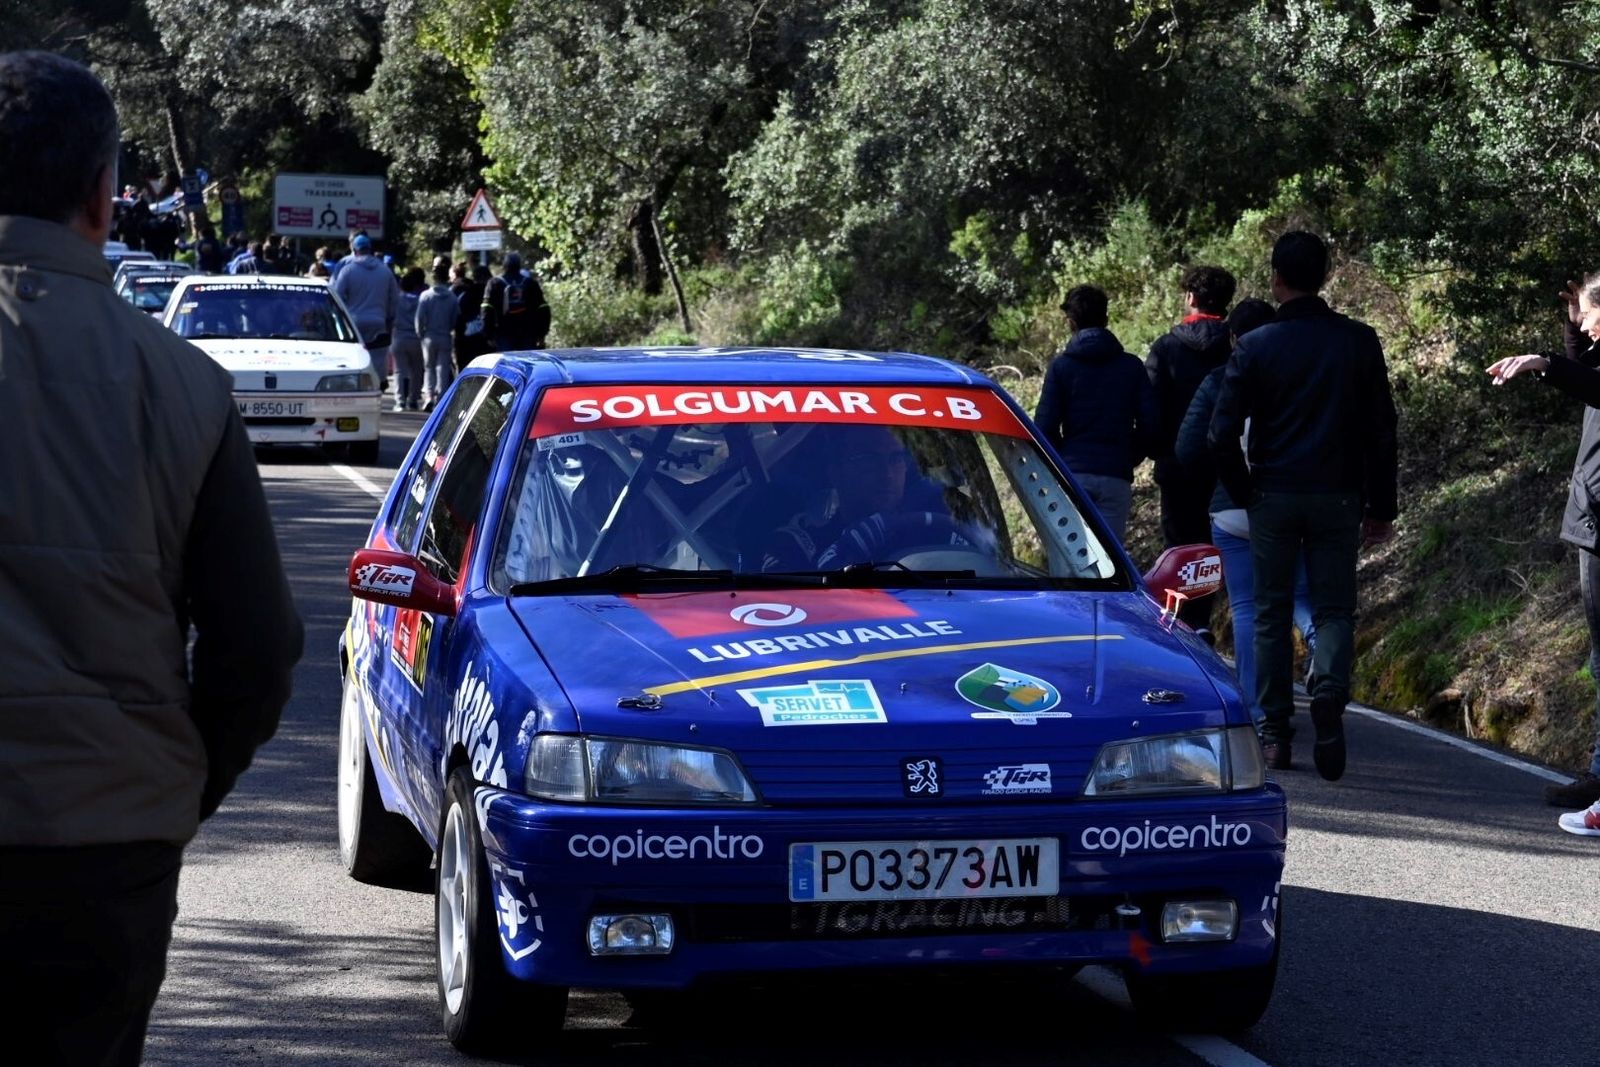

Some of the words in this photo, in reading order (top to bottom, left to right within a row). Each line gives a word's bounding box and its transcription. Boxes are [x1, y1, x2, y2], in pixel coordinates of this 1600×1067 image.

[570, 390, 877, 423] SOLGUMAR
[888, 393, 983, 421] C.B
[558, 434, 581, 444] 401
[368, 565, 412, 585] TGR
[1191, 561, 1219, 582] TGR
[687, 620, 963, 663] LUBRIVALLE
[773, 696, 844, 712] SERVET
[780, 712, 868, 721] Pedroches
[1002, 767, 1049, 788] TGR
[568, 825, 764, 866] copicentro
[1081, 814, 1251, 858] copicentro
[799, 878, 808, 890] E
